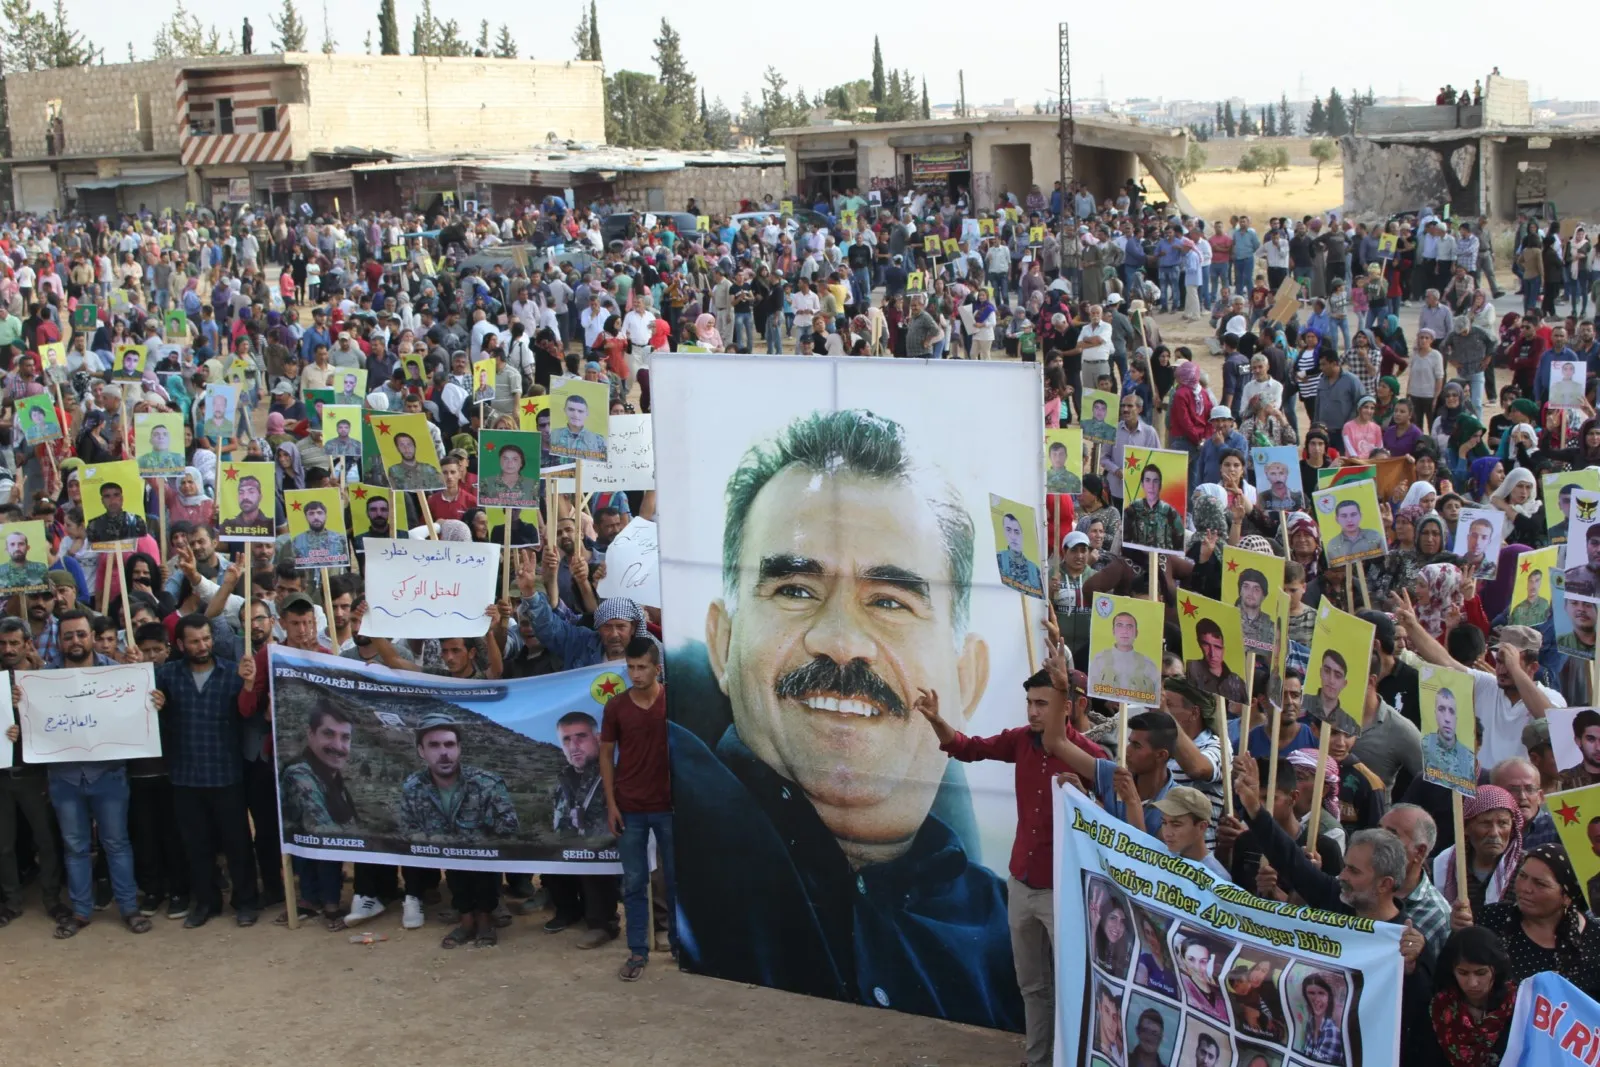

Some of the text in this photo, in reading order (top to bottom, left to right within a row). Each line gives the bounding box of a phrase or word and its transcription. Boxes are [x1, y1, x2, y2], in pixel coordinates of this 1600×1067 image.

[322, 837, 365, 848] KARKER
[442, 847, 499, 858] QEHREMAN
[1098, 824, 1116, 848] Bi
[1299, 906, 1375, 933] Serkevin
[1154, 880, 1201, 915] Rêber
[1200, 903, 1238, 929] Apo
[1294, 929, 1342, 958] Bikin
[1532, 993, 1569, 1040] Bi
